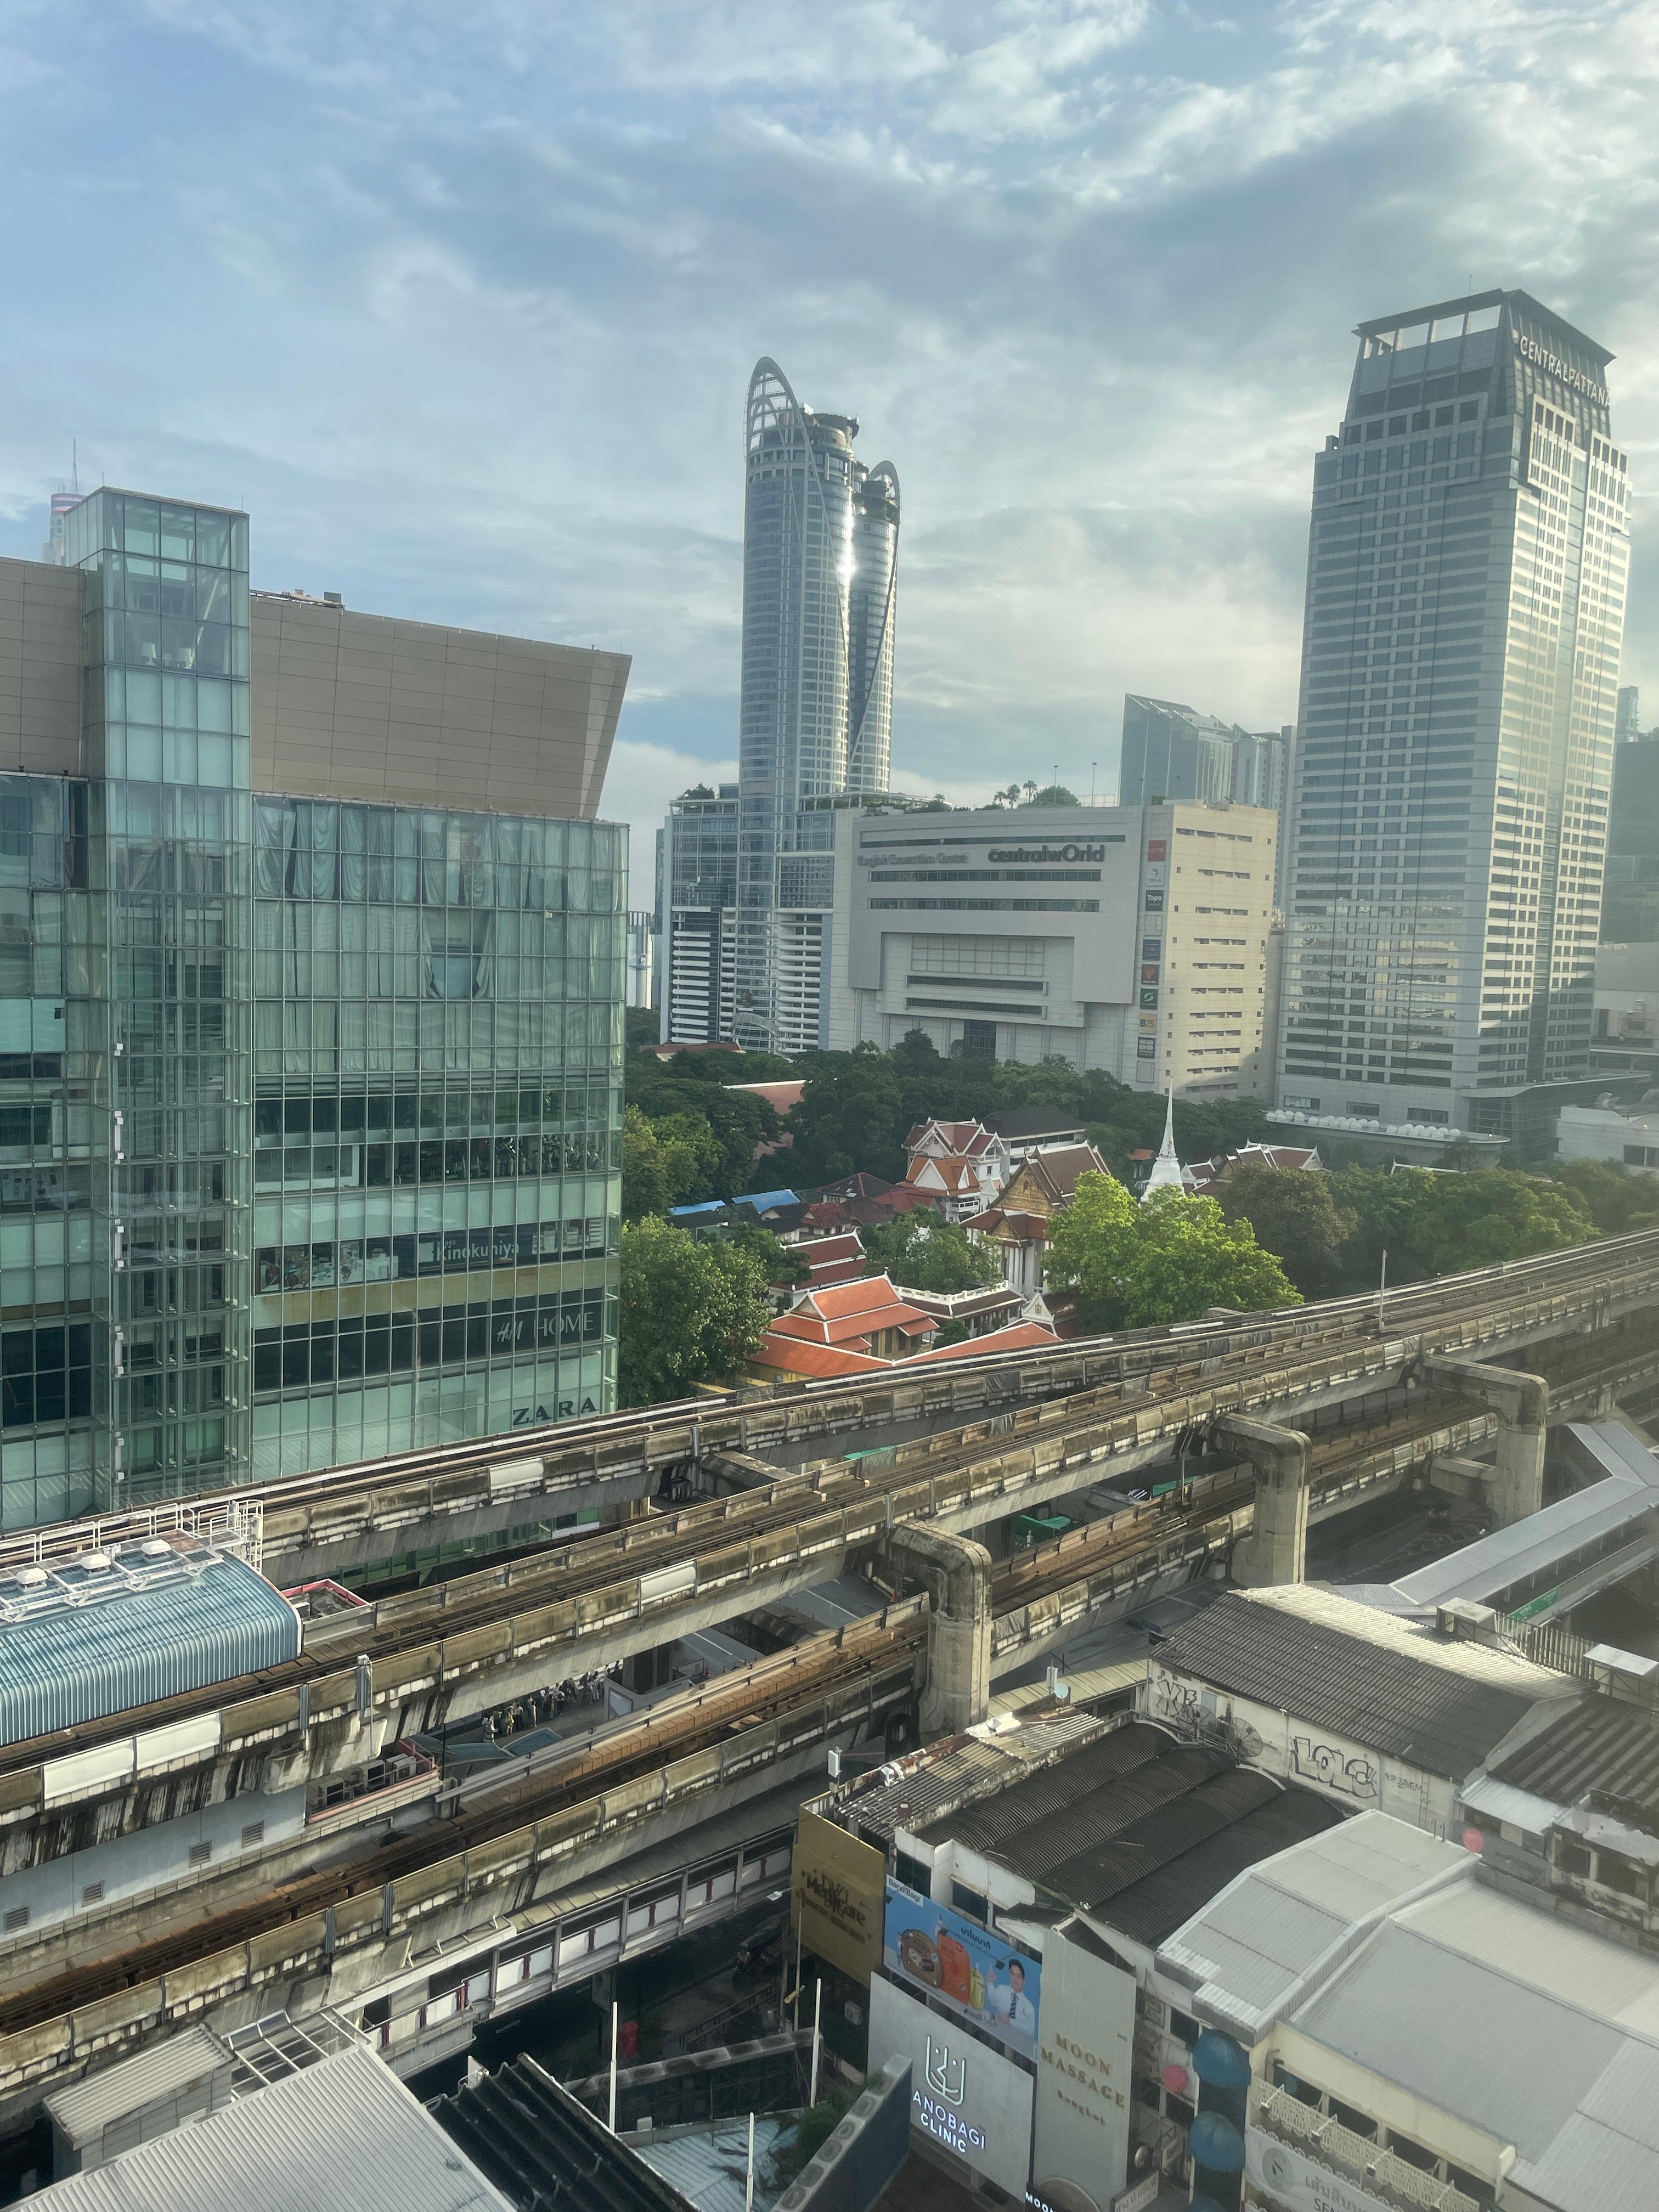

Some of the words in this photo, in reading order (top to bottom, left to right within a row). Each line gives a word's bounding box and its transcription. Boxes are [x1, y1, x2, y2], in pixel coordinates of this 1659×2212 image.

[1147, 894, 1163, 902] Tops
[437, 1240, 520, 1261] Kinokuniya
[496, 1321, 523, 1342] H&M
[533, 1311, 594, 1338] HOME
[512, 1397, 599, 1426] ZARA
[1056, 2033, 1112, 2076] MOON
[1041, 2046, 1125, 2108] MASSAGE
[912, 2090, 986, 2150] ANOBAGI
[920, 2112, 967, 2153] CLINIC
